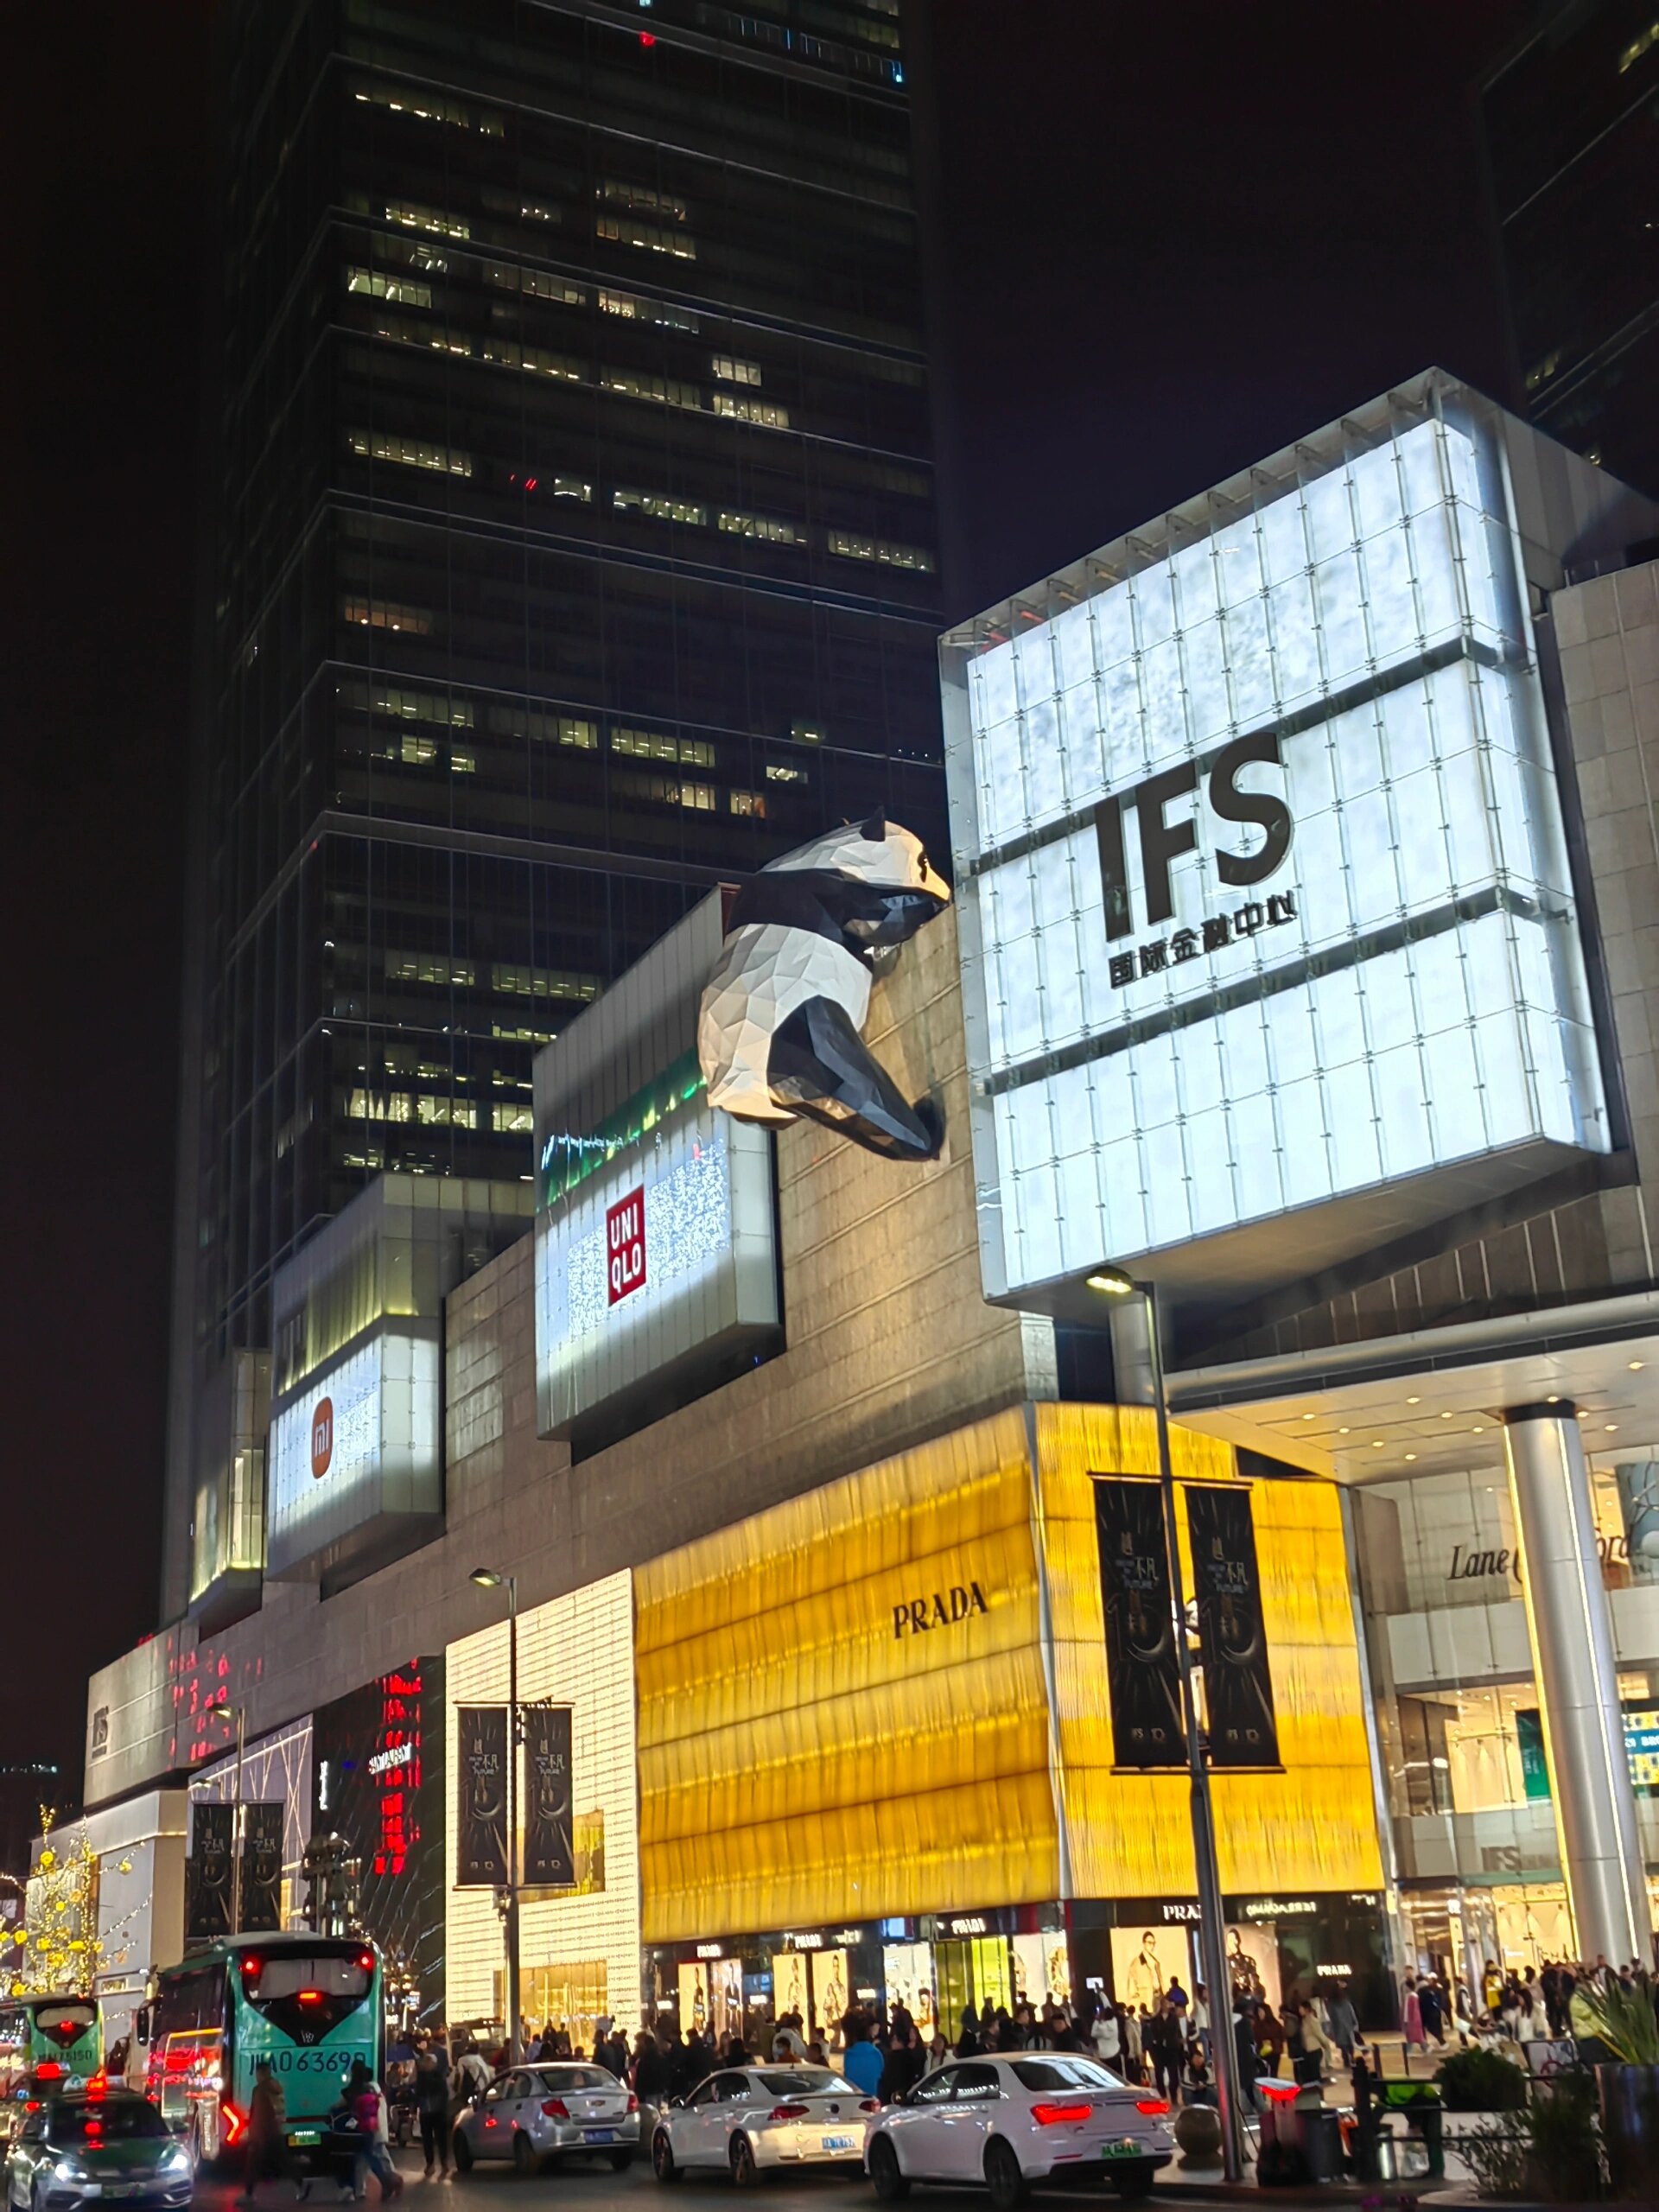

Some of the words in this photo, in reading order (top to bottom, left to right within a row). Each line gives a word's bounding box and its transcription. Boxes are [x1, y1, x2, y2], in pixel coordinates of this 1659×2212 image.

[1094, 732, 1293, 943] IFS
[610, 1203, 639, 1249] UNI
[611, 1243, 641, 1294] QLO
[1448, 1545, 1510, 1580] Lane
[892, 1581, 988, 1639] PRADA
[1481, 1846, 1522, 1872] IFS
[1162, 1904, 1202, 1921] PRA
